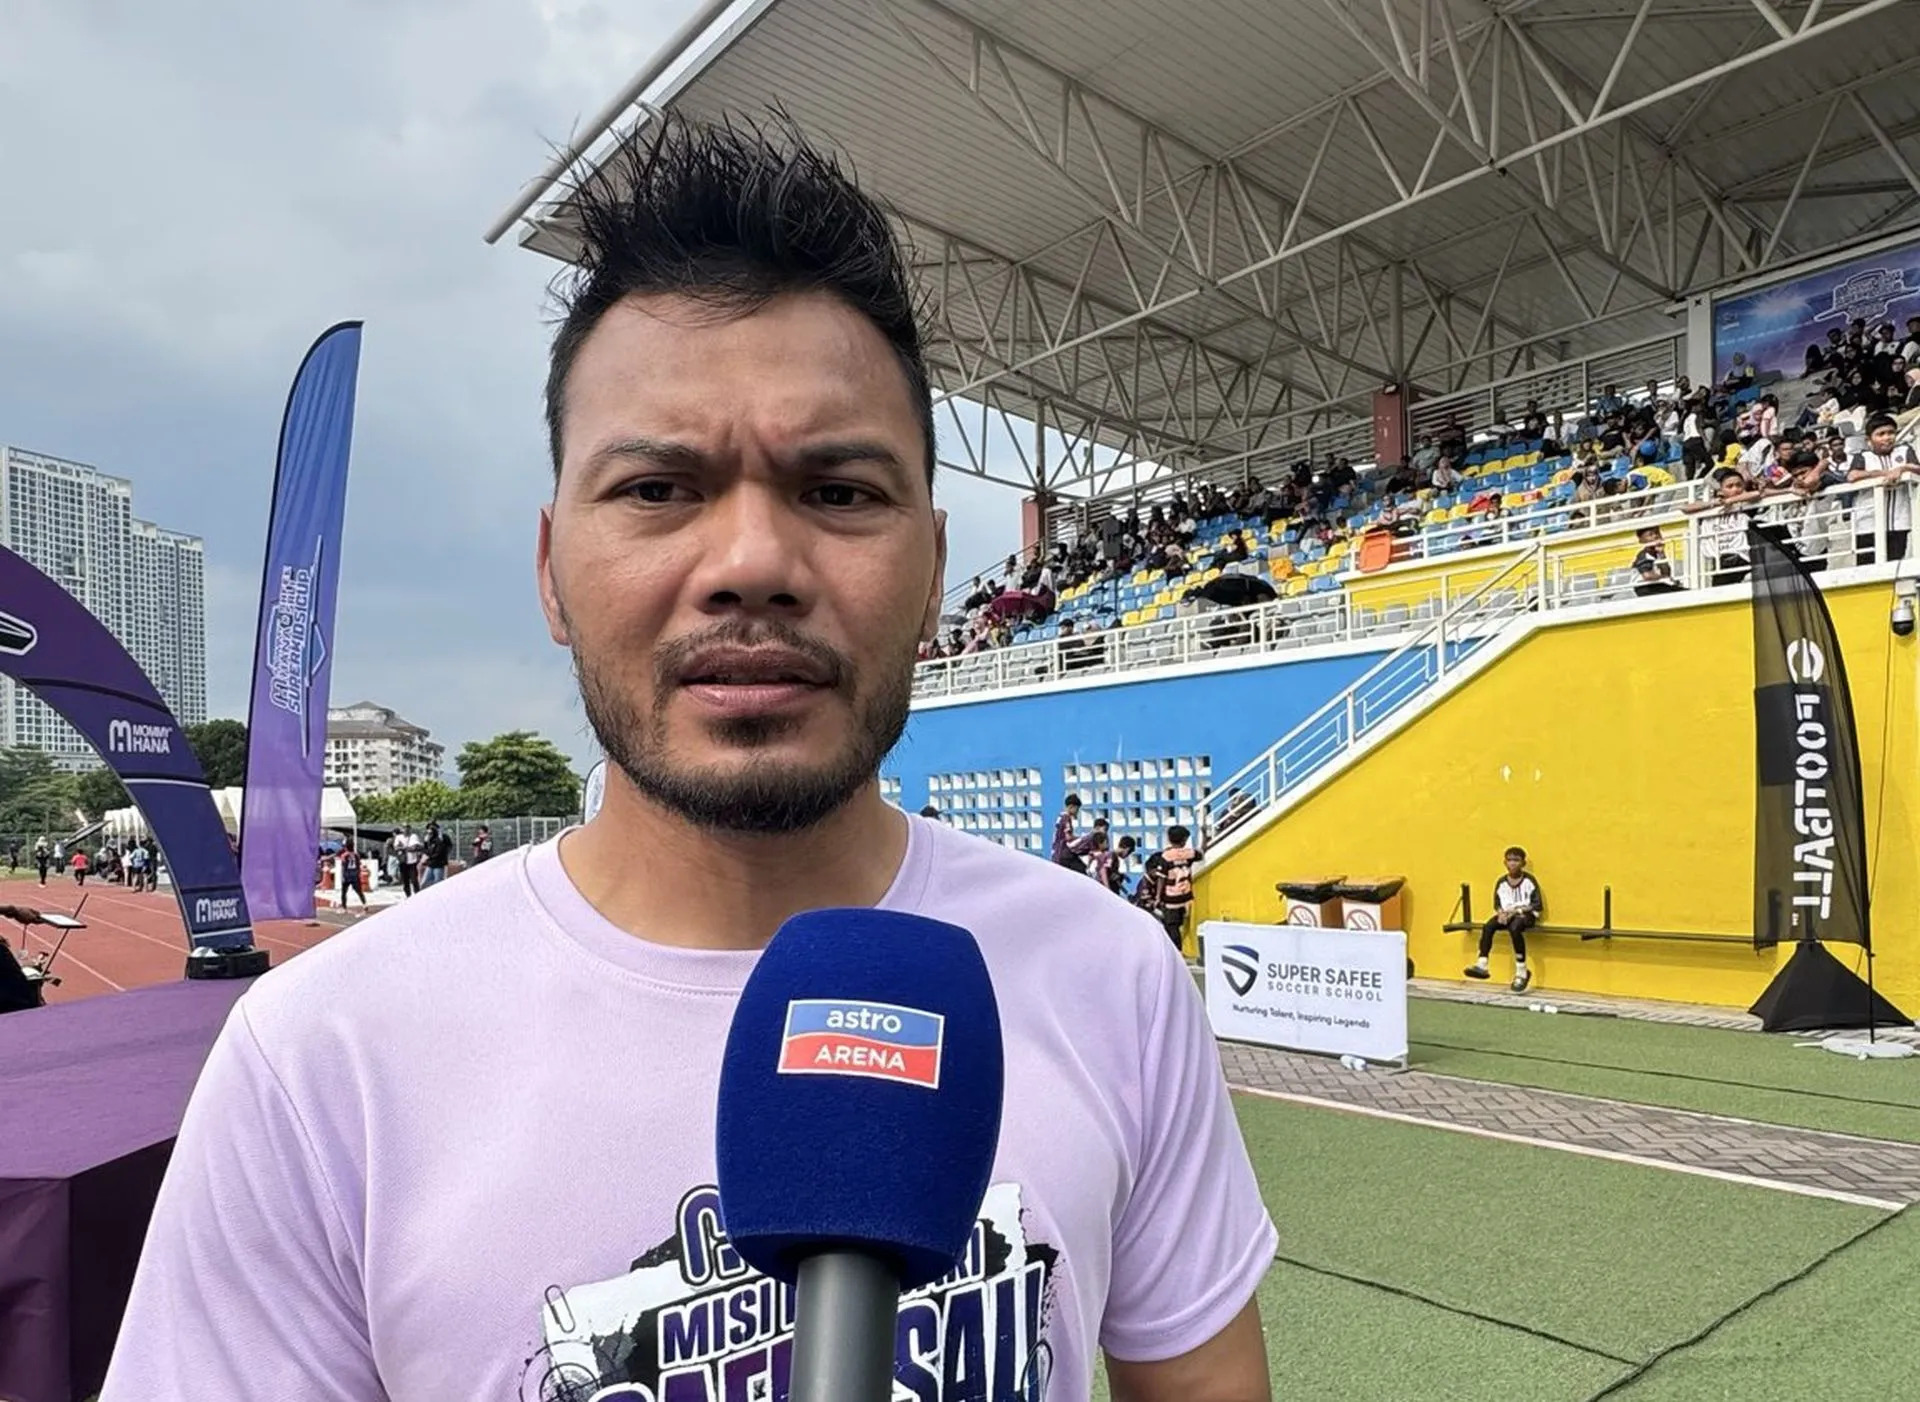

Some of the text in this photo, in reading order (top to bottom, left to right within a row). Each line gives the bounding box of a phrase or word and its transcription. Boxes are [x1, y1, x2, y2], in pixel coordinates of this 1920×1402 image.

[133, 736, 171, 754] HANA
[1267, 963, 1382, 989] SUPER SAFEE
[1268, 981, 1383, 1002] SOCCER SCHOOL
[827, 1008, 901, 1033] astro
[1233, 1003, 1370, 1029] Nurturing Talent, Inspiring Legends
[814, 1044, 906, 1072] ARENA
[662, 1281, 772, 1366] MISI
